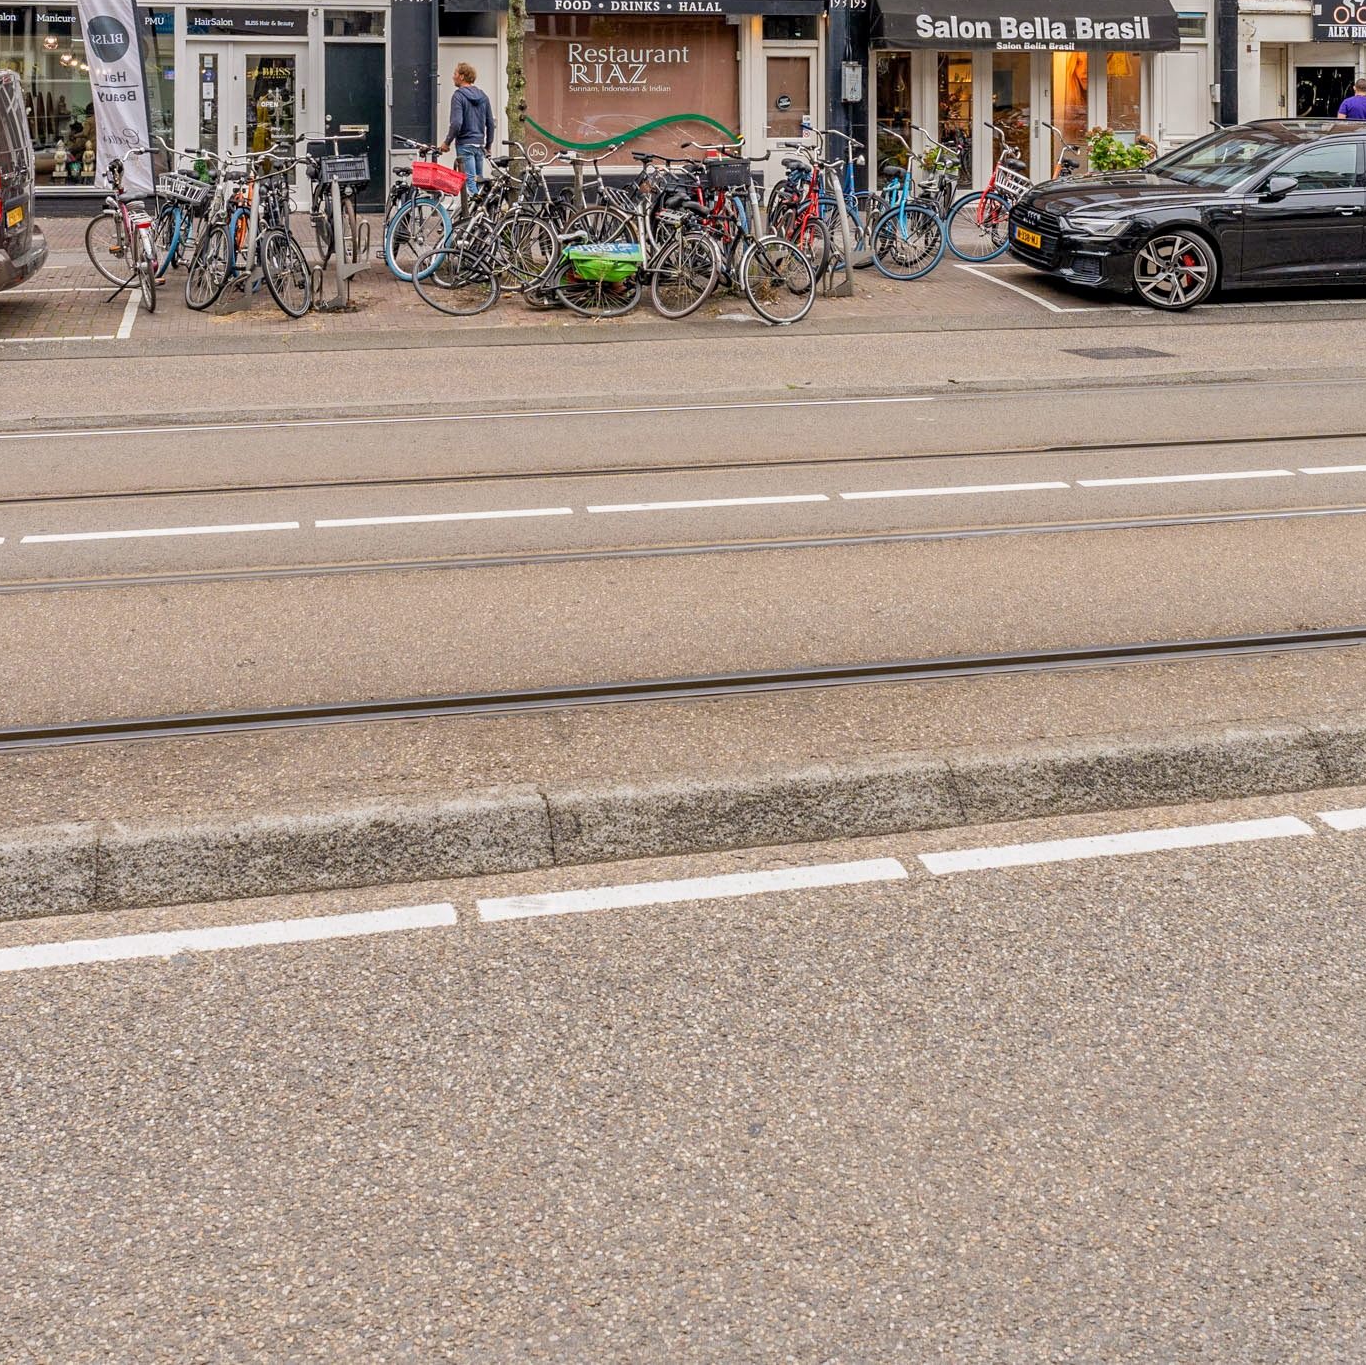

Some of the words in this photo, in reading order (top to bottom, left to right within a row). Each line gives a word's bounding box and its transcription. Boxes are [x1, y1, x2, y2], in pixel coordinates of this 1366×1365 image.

[554, 0, 592, 10] FOOD
[611, 0, 661, 11] DRINKS
[678, 1, 723, 12] HALAL
[36, 13, 76, 23] Manicure
[144, 17, 165, 25] PMU
[194, 17, 234, 26] HairSalon
[916, 14, 991, 39] Salon
[999, 16, 1067, 40] Bella
[1074, 16, 1151, 40] Brasil
[1328, 26, 1350, 38] ALEX
[996, 42, 1022, 50] Salon
[1024, 42, 1047, 50] Bella
[1049, 42, 1075, 50] Brasil
[568, 43, 690, 63] Restaurant
[262, 67, 291, 76] BLISS
[569, 63, 648, 84] RIAZ
